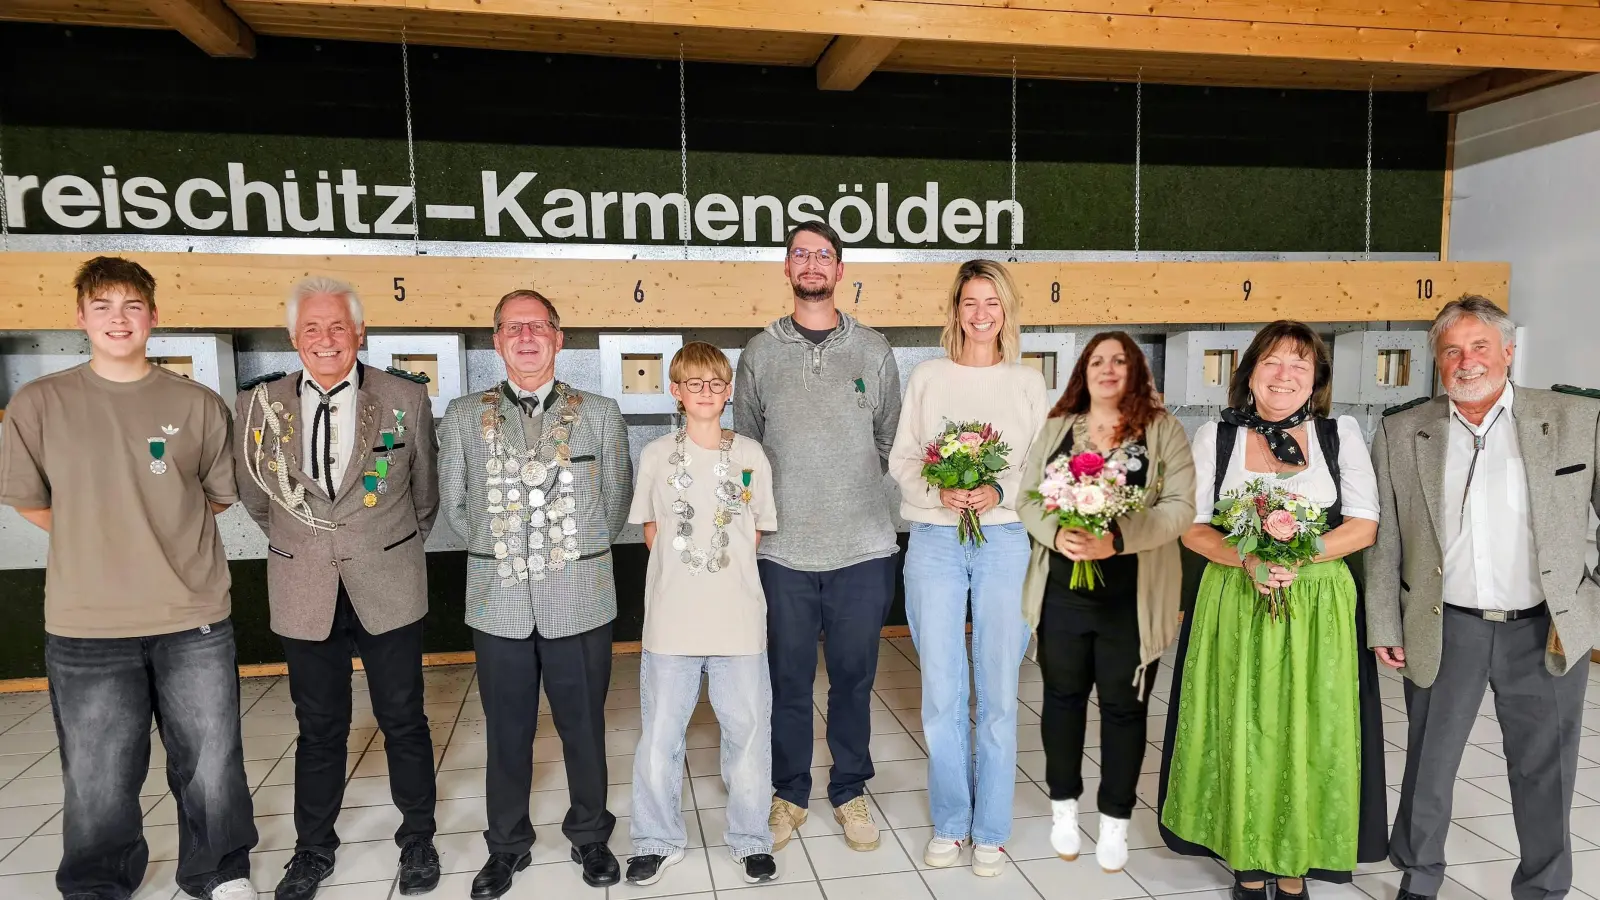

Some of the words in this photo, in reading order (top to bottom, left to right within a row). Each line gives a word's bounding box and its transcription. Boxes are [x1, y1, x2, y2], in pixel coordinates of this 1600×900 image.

[393, 277, 406, 302] 5
[633, 279, 645, 303] 6
[853, 281, 863, 304] 7
[1051, 281, 1061, 303] 8
[1242, 280, 1252, 302] 9
[1416, 278, 1433, 300] 10
